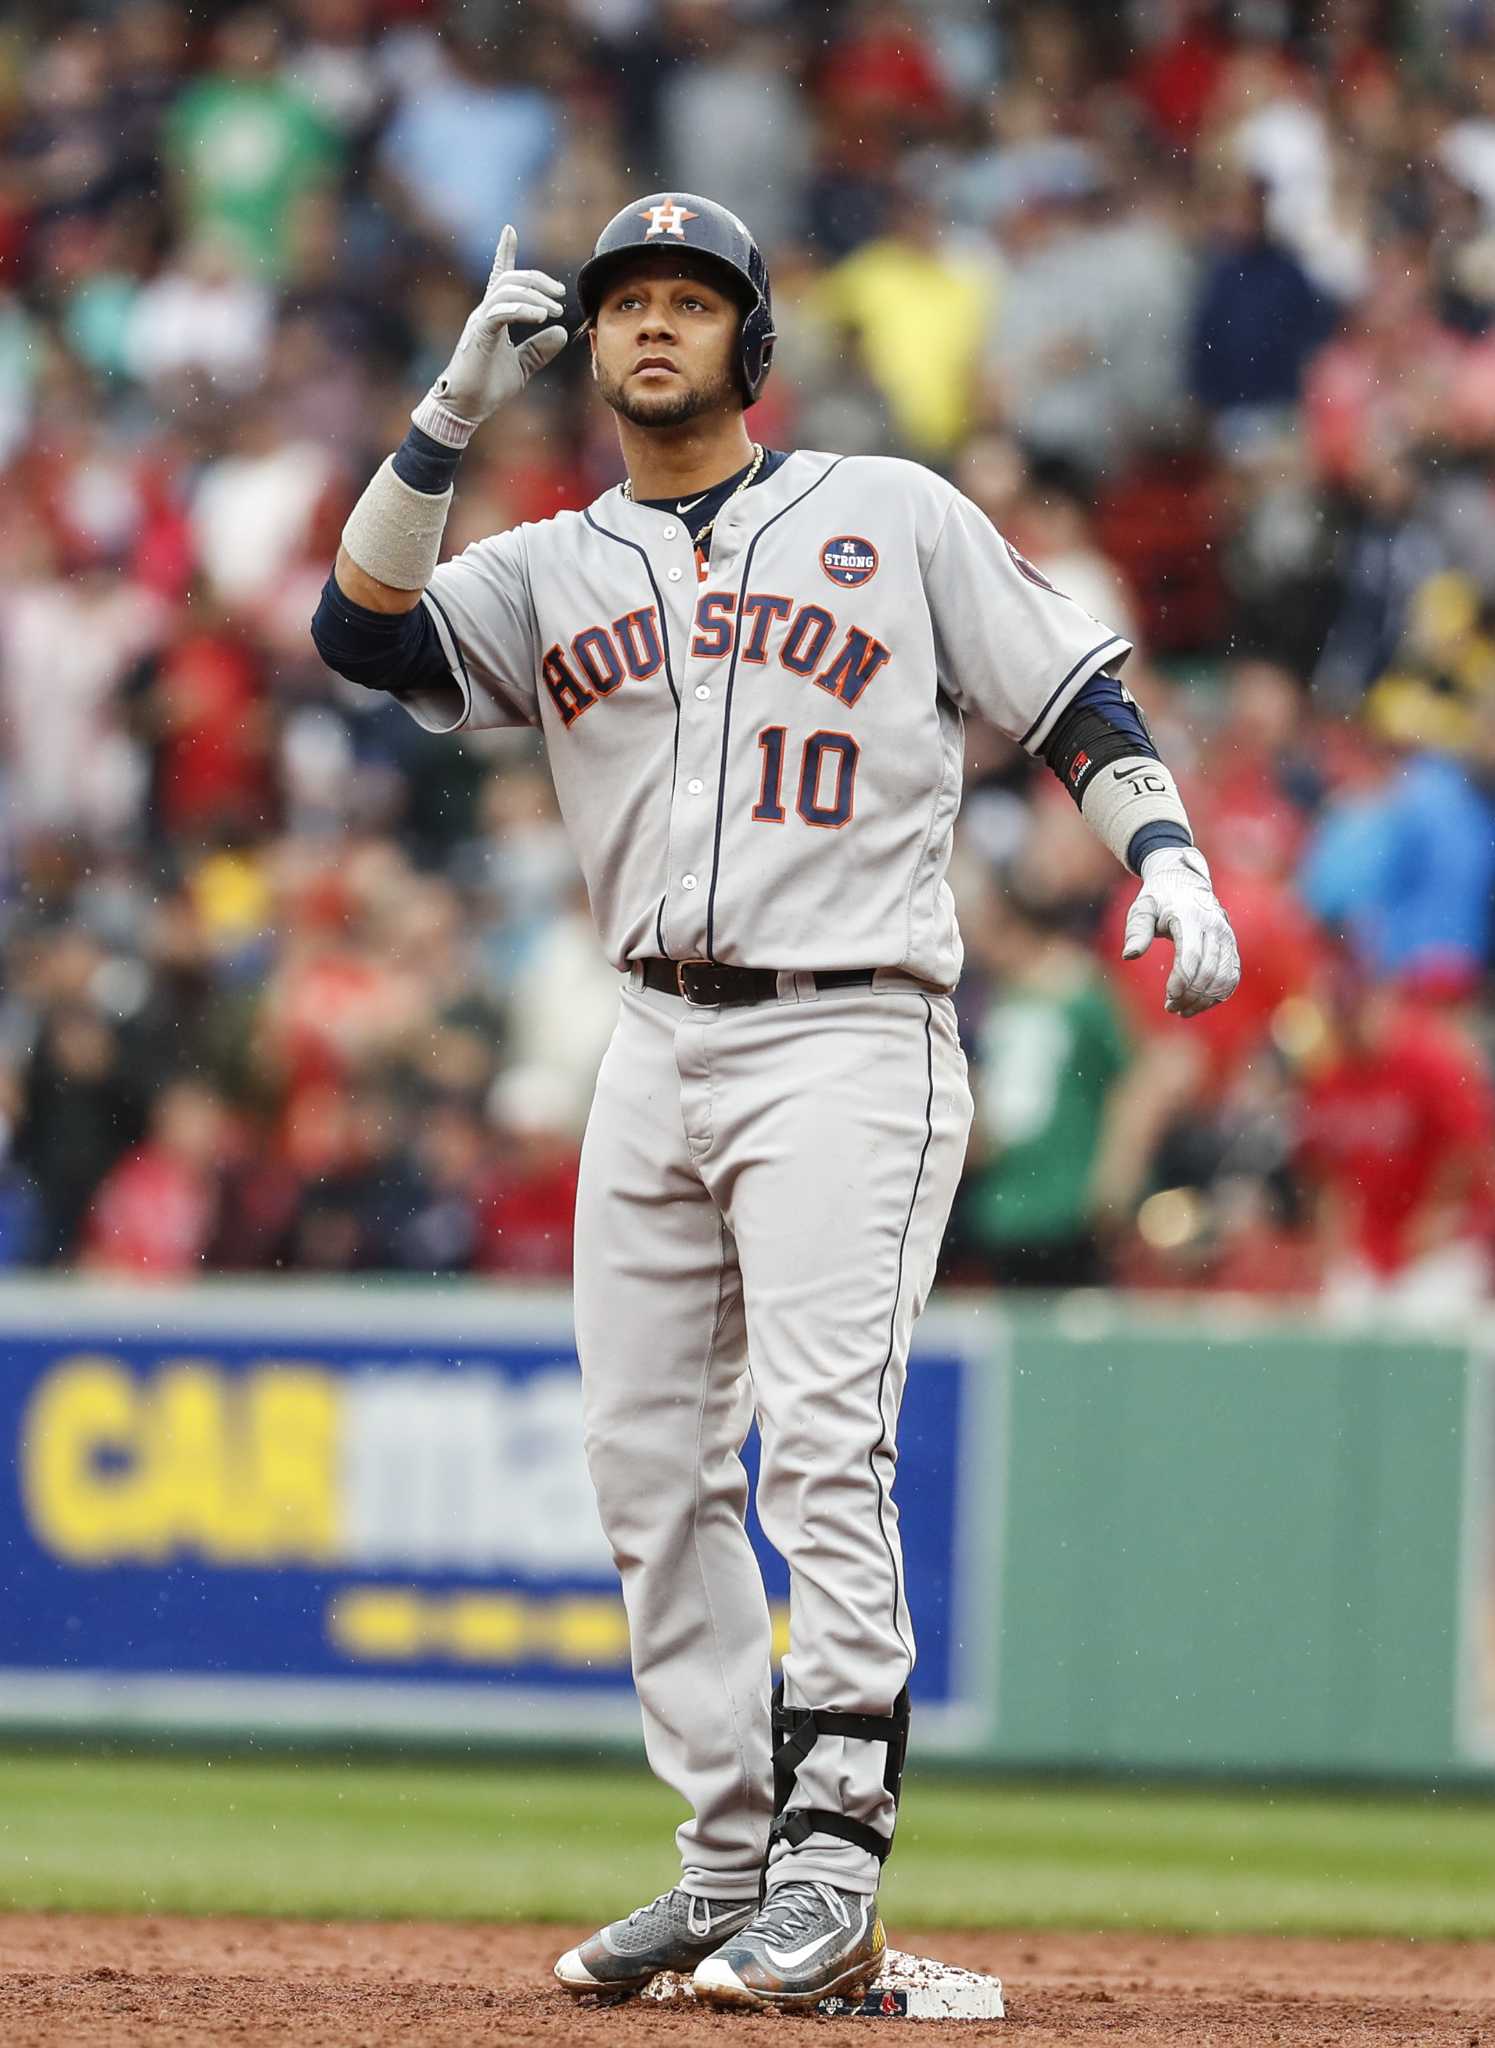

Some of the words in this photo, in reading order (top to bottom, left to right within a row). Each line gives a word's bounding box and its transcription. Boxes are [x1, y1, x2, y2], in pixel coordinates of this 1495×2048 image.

[646, 206, 687, 234] H
[824, 553, 874, 568] STRONG
[542, 591, 892, 730] HOUSTON
[751, 725, 860, 829] 10
